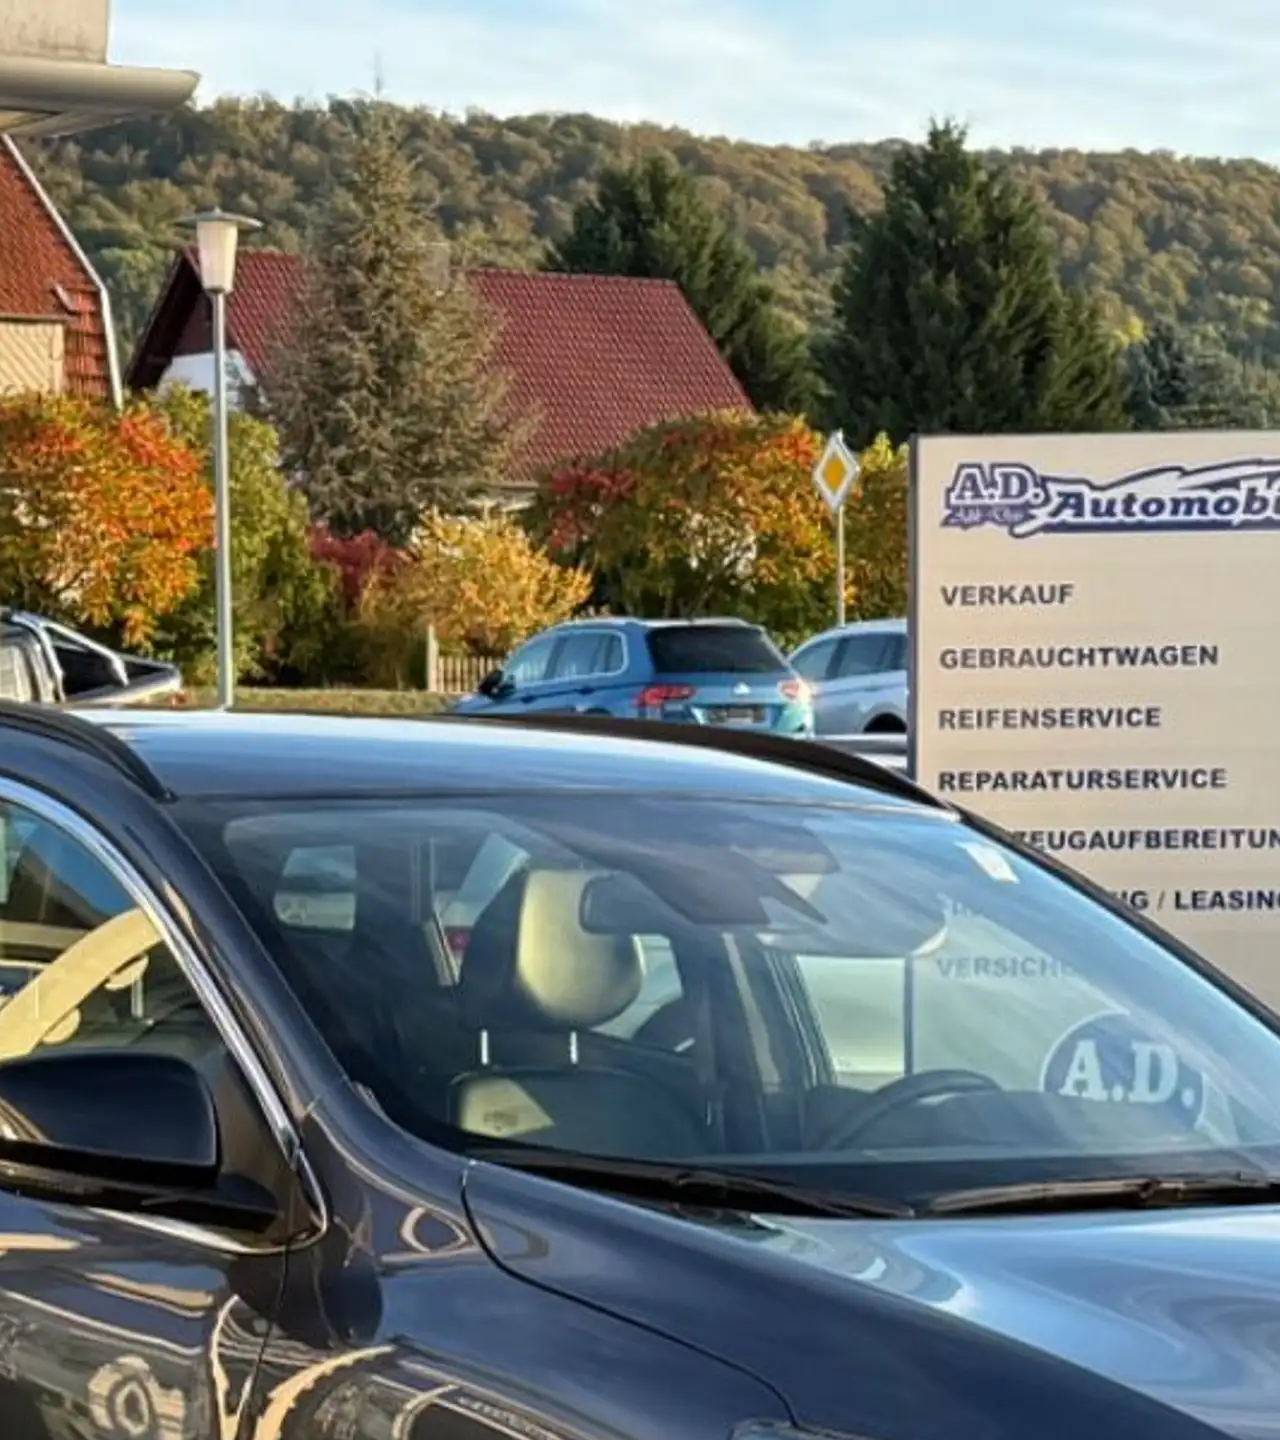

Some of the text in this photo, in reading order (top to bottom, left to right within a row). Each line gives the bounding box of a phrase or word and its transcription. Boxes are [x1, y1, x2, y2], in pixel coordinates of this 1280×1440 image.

[950, 468, 1042, 502] A.D.
[940, 584, 1074, 606] VERKAUF
[939, 645, 1218, 670] GEBRAUCHTWAGEN
[938, 708, 1161, 730] REIFENSERVICE
[938, 768, 1227, 792] REPARATURSERVICE
[1058, 1039, 1195, 1109] A.D.
